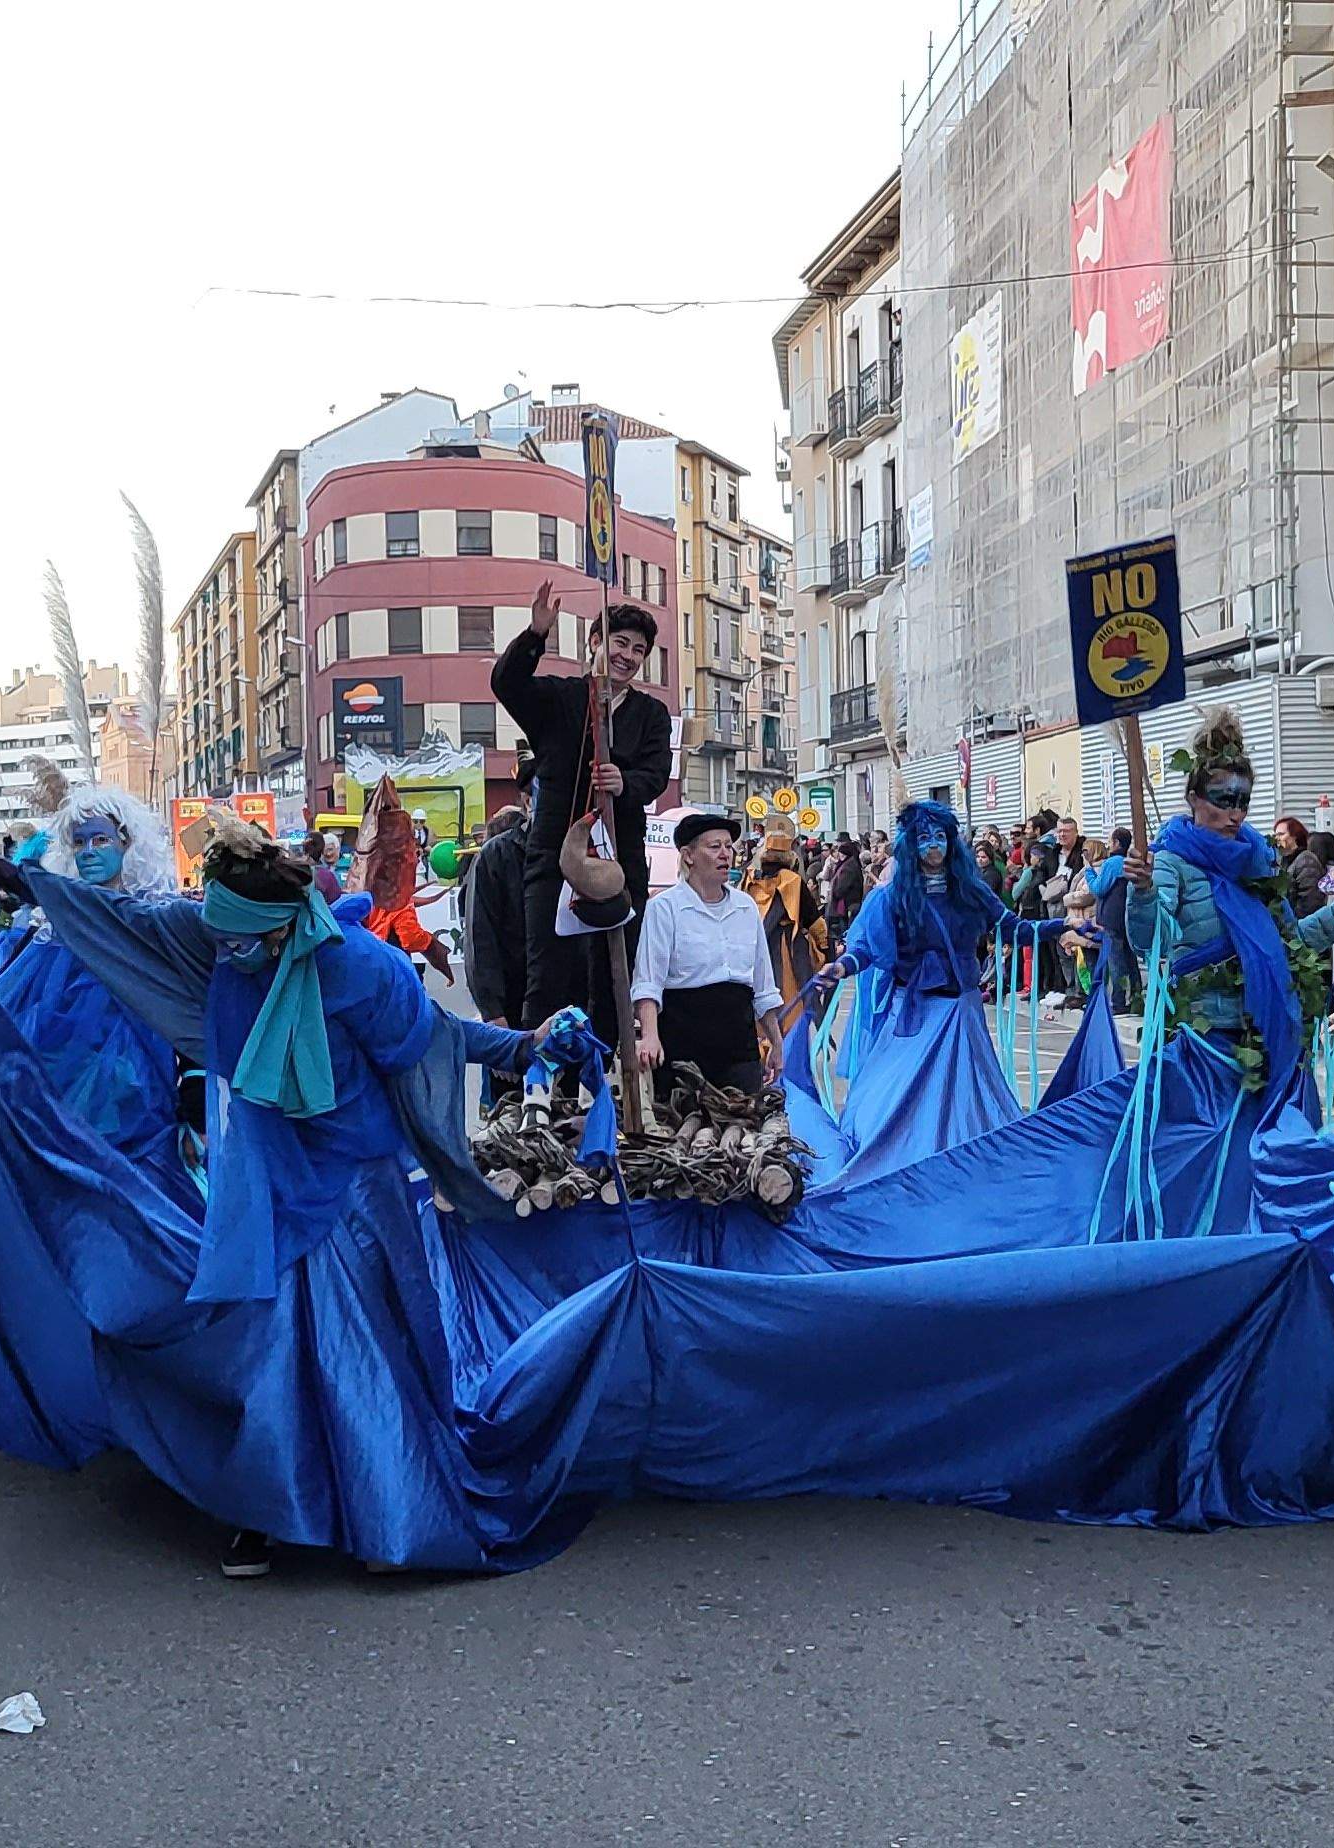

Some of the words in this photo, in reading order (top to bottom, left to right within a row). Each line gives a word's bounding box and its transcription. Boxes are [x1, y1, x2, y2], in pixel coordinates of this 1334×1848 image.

[1091, 563, 1157, 619] NO
[1119, 678, 1145, 694] VIVO
[343, 714, 386, 724] REPSOL
[651, 823, 664, 832] DE
[647, 834, 670, 844] ELLO
